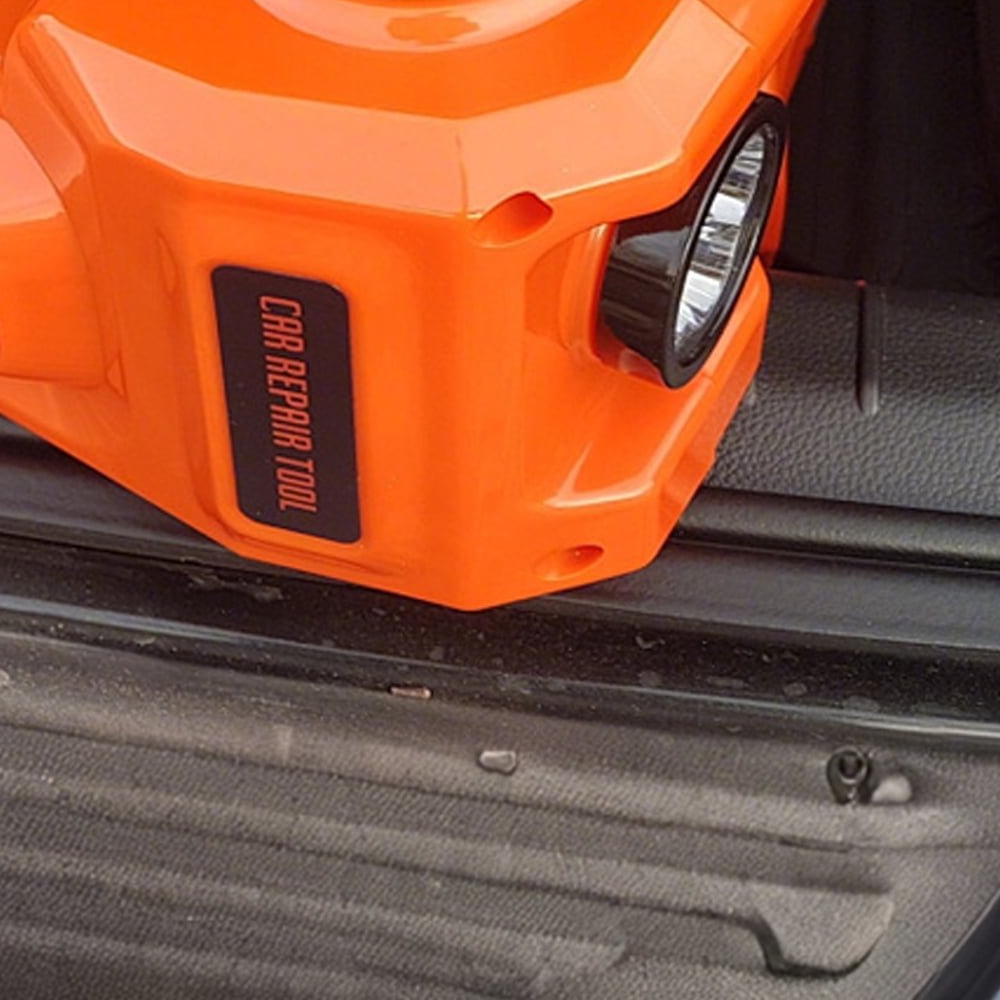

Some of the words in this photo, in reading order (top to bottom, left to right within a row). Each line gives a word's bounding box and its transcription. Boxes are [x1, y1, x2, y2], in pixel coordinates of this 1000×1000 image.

[259, 296, 304, 353] CAR
[265, 355, 312, 452] REPAIR
[275, 456, 317, 512] TOOL
